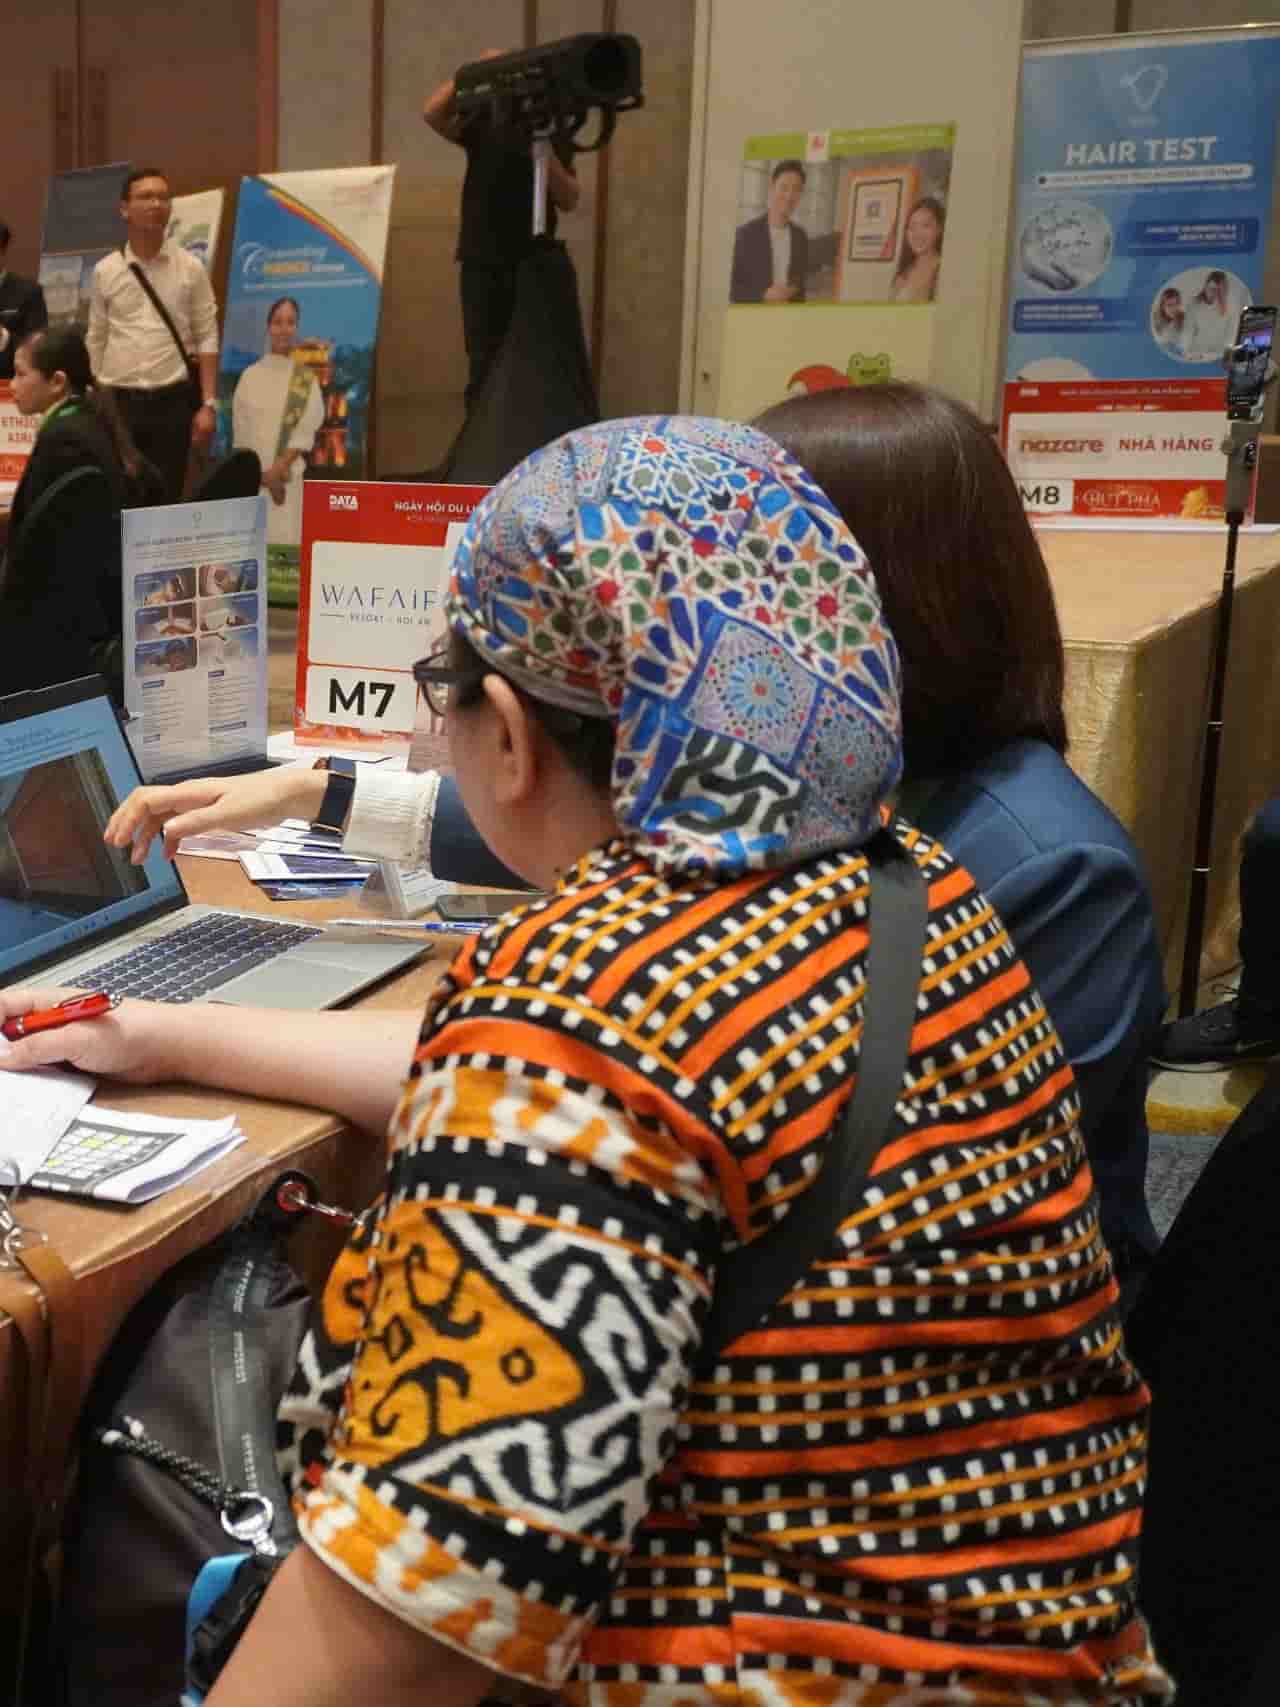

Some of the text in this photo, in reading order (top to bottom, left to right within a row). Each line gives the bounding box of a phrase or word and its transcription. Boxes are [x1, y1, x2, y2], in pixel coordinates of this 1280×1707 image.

[1064, 135, 1218, 167] HAIR TEST
[1020, 437, 1105, 454] nazare
[329, 494, 359, 505] DATA
[1020, 485, 1060, 505] M8
[447, 503, 464, 513] DU
[320, 583, 438, 611] WAFAIF
[329, 677, 396, 718] M7
